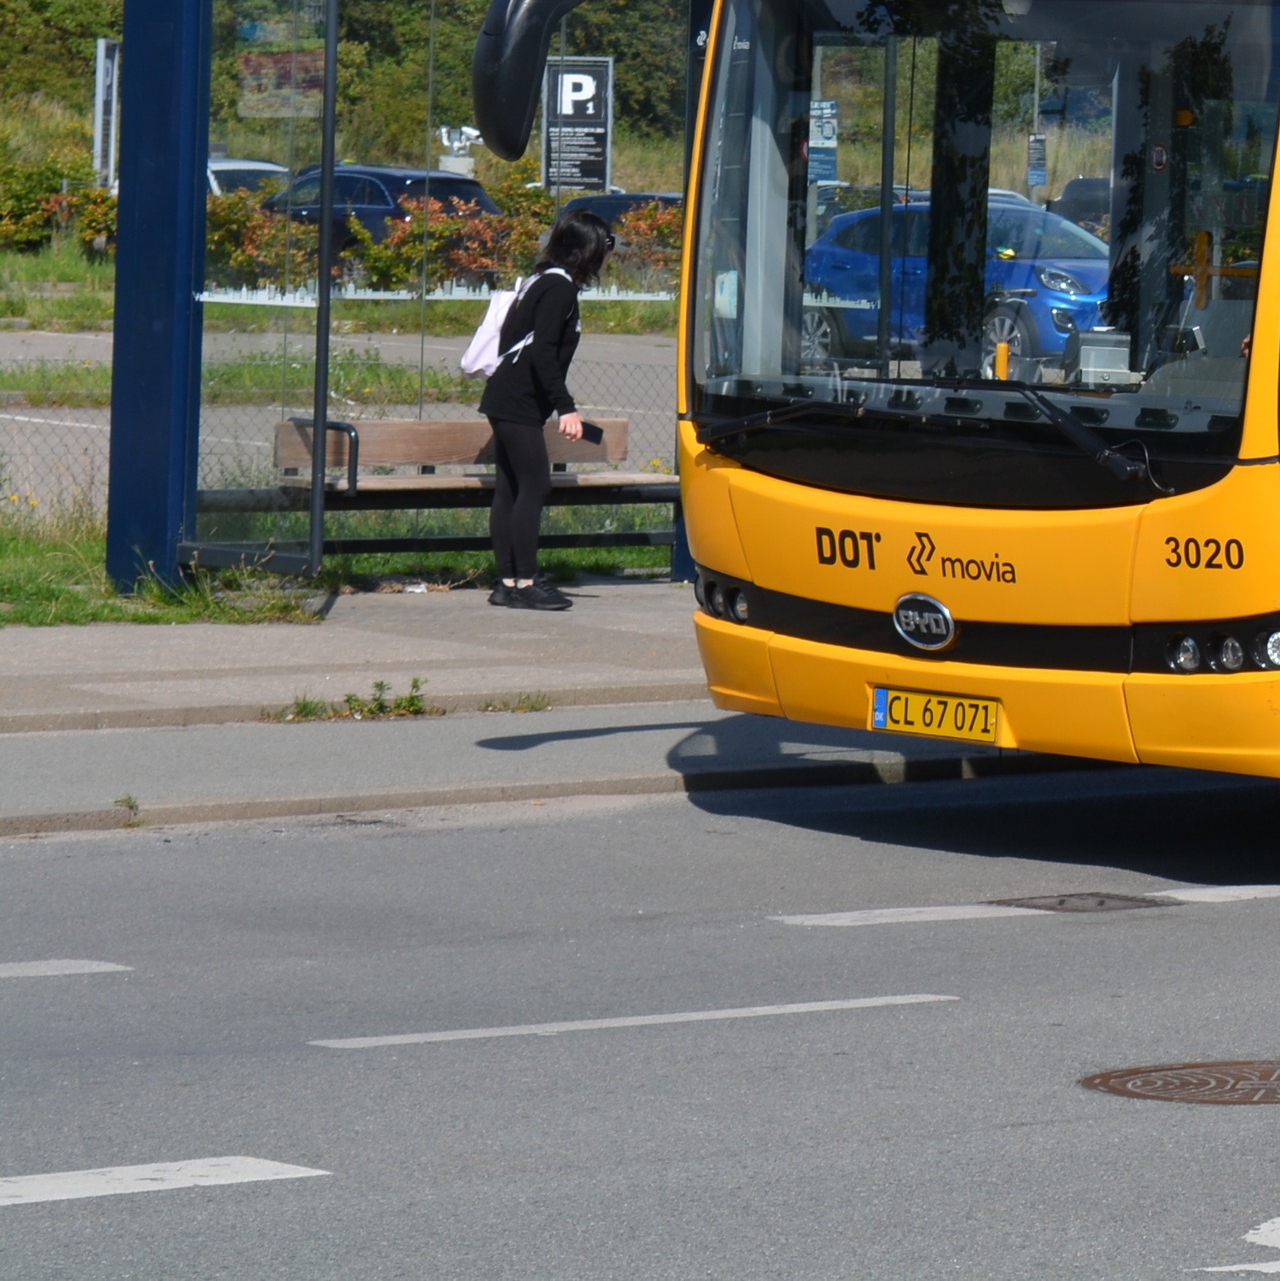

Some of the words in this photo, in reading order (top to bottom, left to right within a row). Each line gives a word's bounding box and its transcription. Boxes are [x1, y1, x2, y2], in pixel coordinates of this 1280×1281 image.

[815, 526, 881, 571] DOT
[1163, 535, 1245, 571] 3020
[940, 553, 1017, 584] movia
[898, 609, 947, 635] BYD
[888, 695, 915, 726] CL
[922, 697, 949, 728] 67
[954, 701, 991, 734] 071
